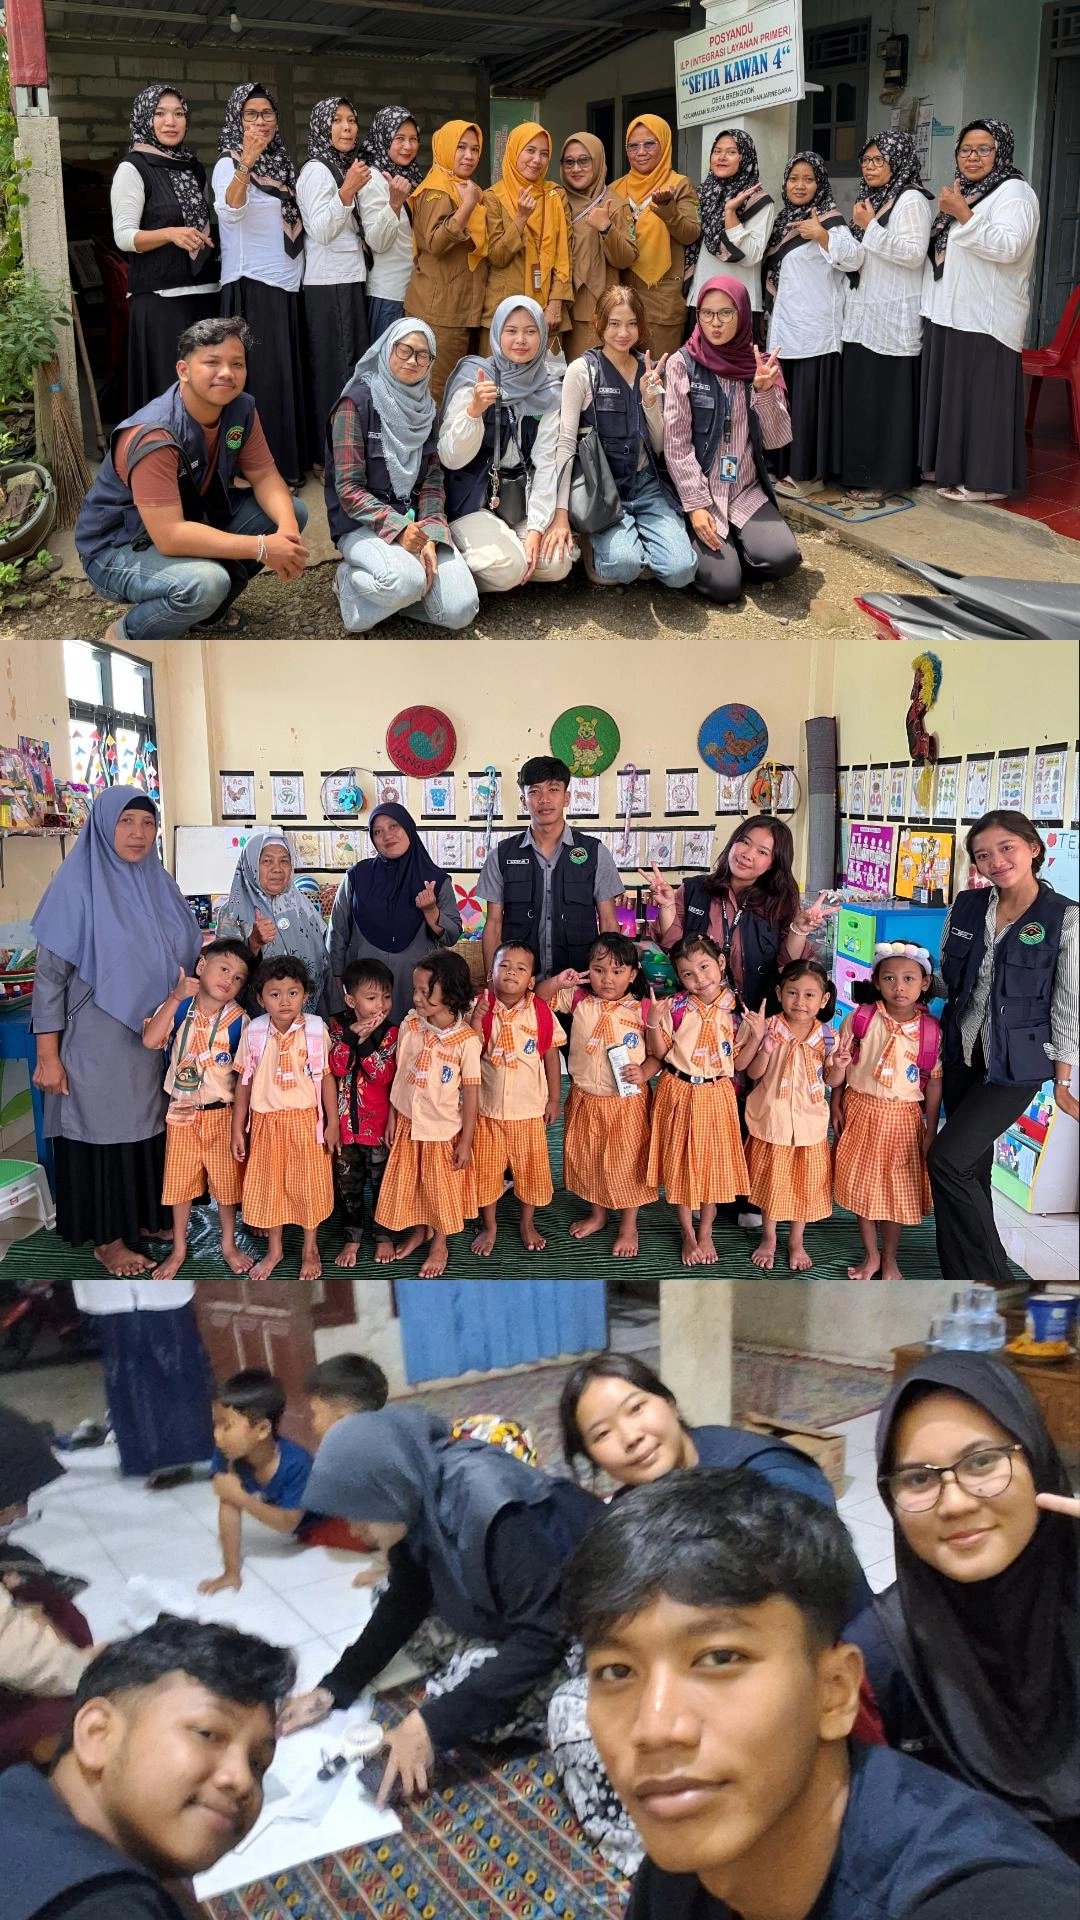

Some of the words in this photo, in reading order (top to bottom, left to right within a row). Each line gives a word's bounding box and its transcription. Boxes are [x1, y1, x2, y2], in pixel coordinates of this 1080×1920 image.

[690, 47, 726, 69] (INTEGRASI
[727, 36, 759, 55] LAYANAN
[760, 25, 791, 43] PRIMER)
[709, 22, 754, 47] POSYANDU
[724, 52, 768, 84] KAWAN
[683, 109, 707, 119] KECAMATAN
[727, 97, 752, 109] KABUPATEN
[753, 86, 792, 102] BANJARNEGARA
[712, 94, 726, 104] DESA
[726, 86, 755, 101] BRENGKOK
